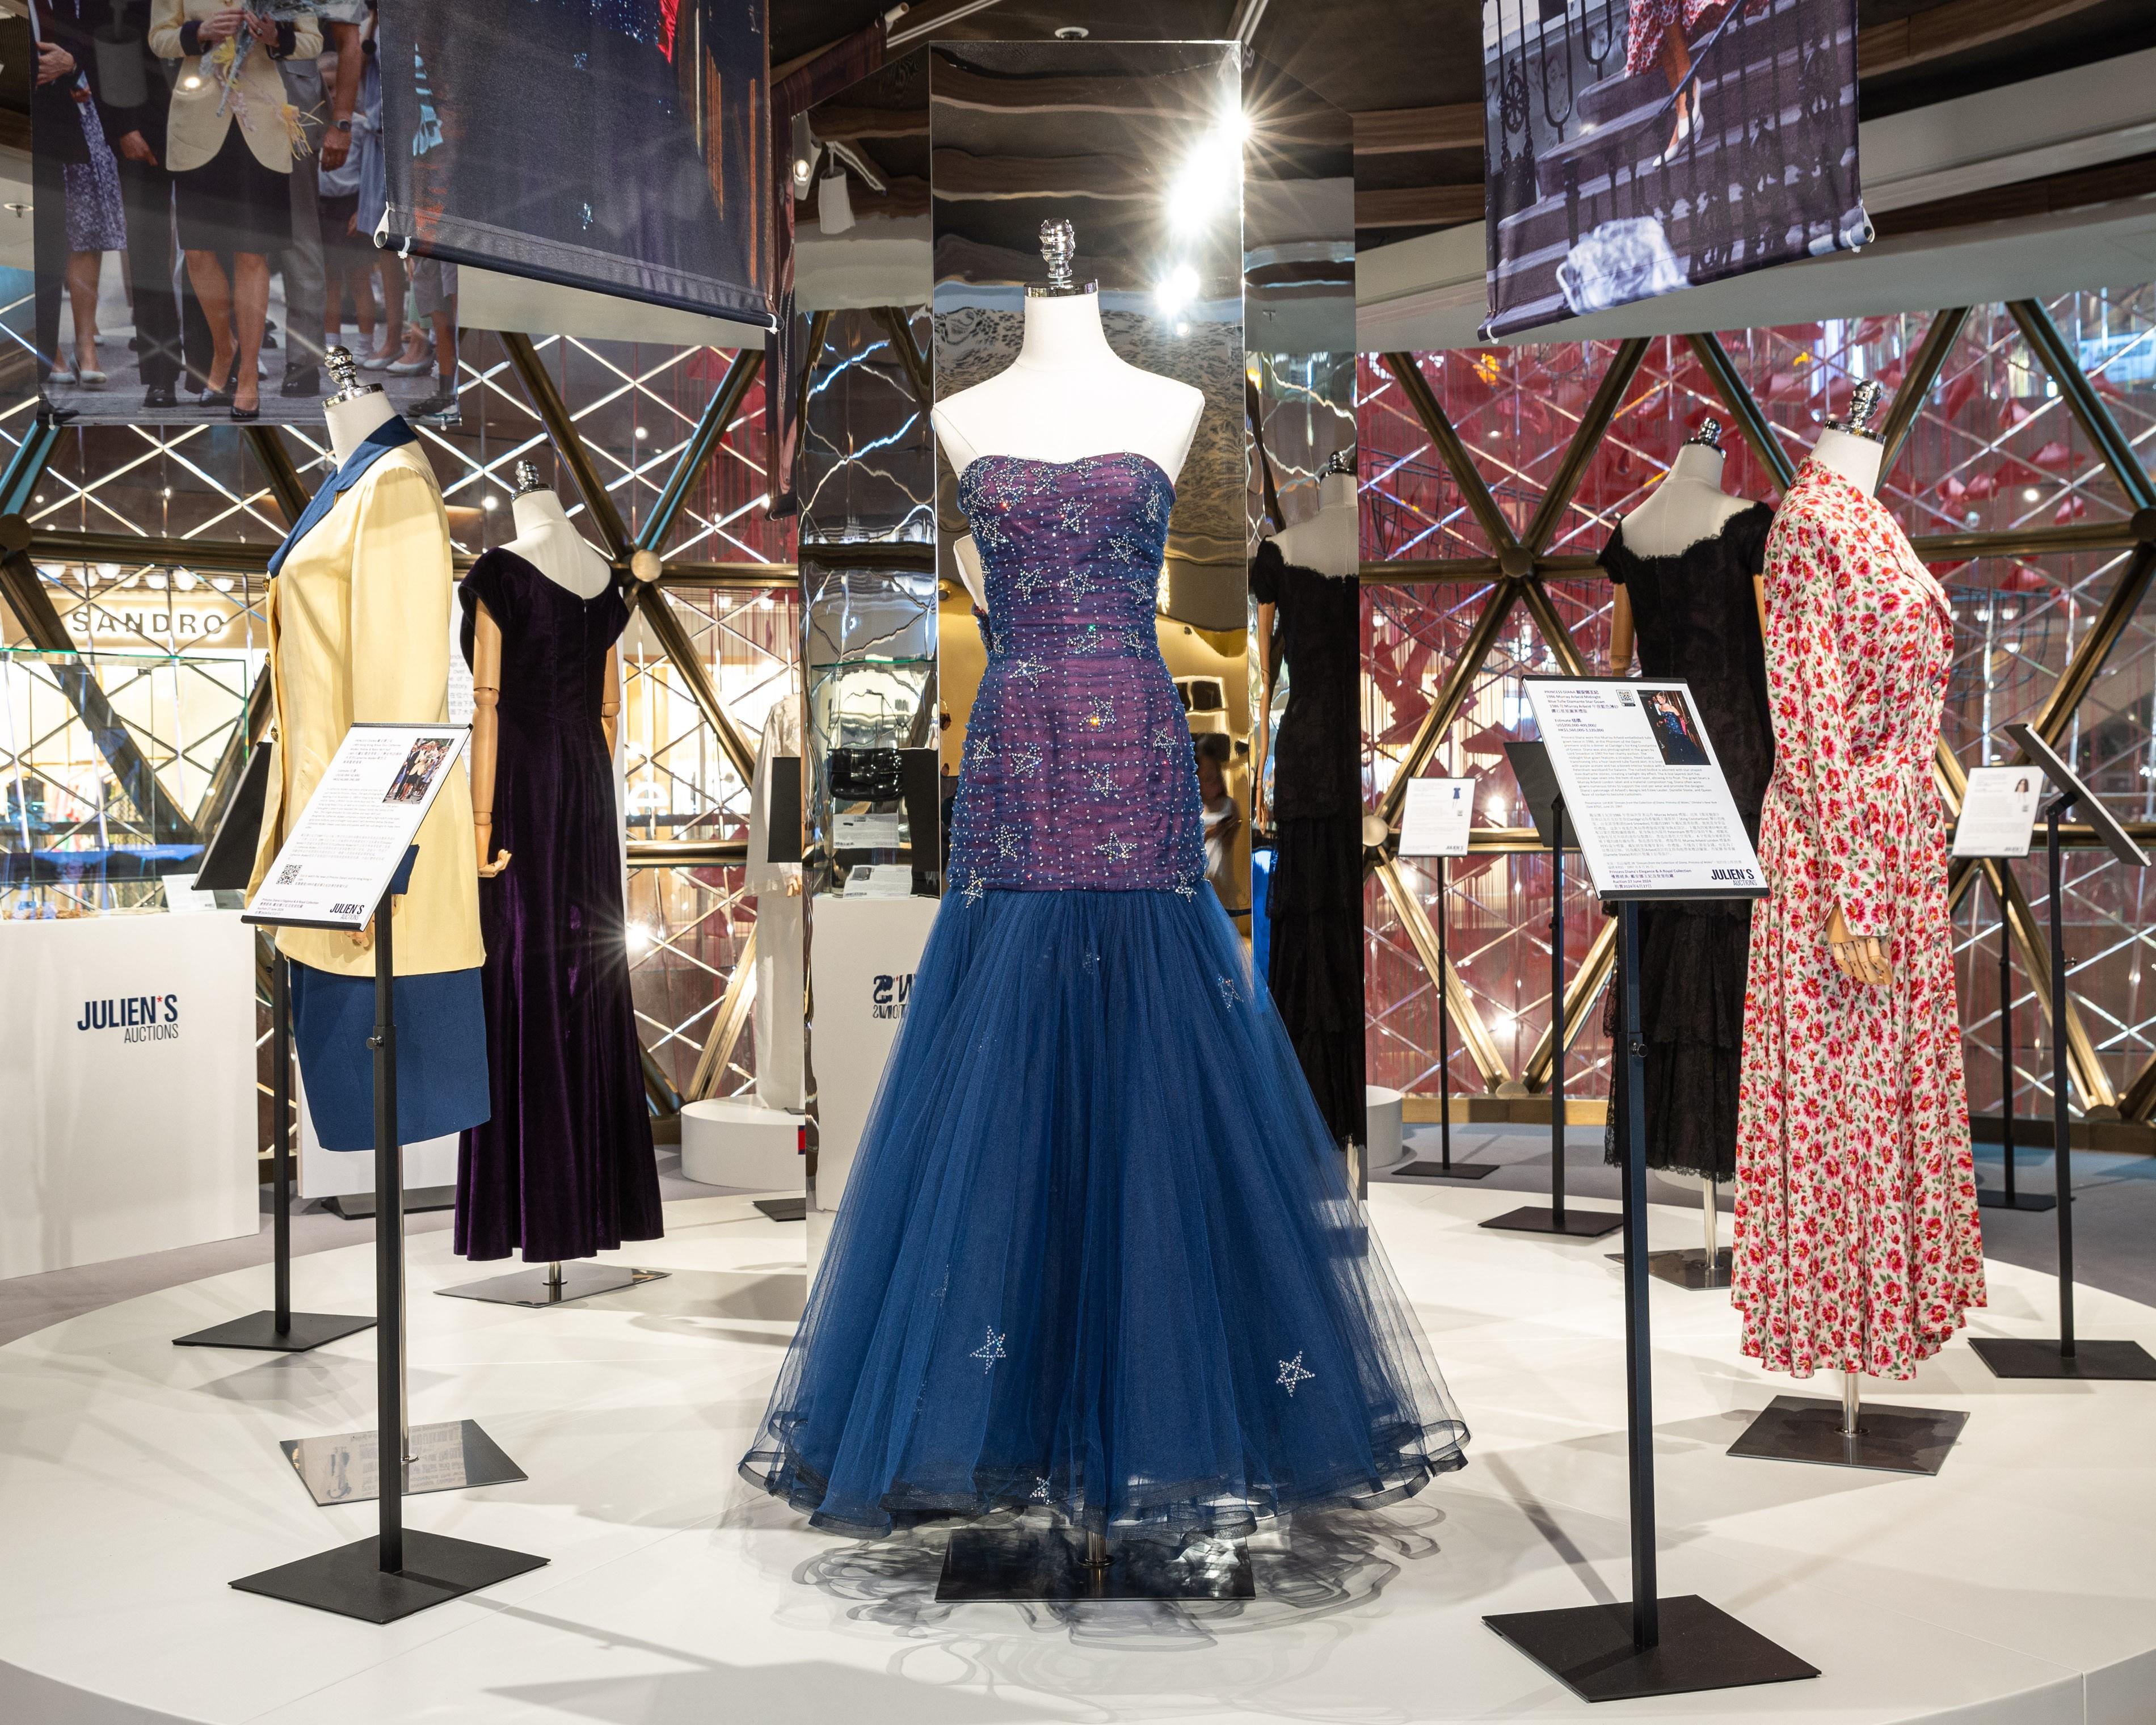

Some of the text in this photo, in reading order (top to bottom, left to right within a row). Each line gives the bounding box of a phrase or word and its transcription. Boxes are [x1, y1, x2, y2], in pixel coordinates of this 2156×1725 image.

[73, 611, 225, 634] SANDRO
[330, 903, 364, 915] JULIEN'S
[124, 1023, 179, 1043] AUCTIONS
